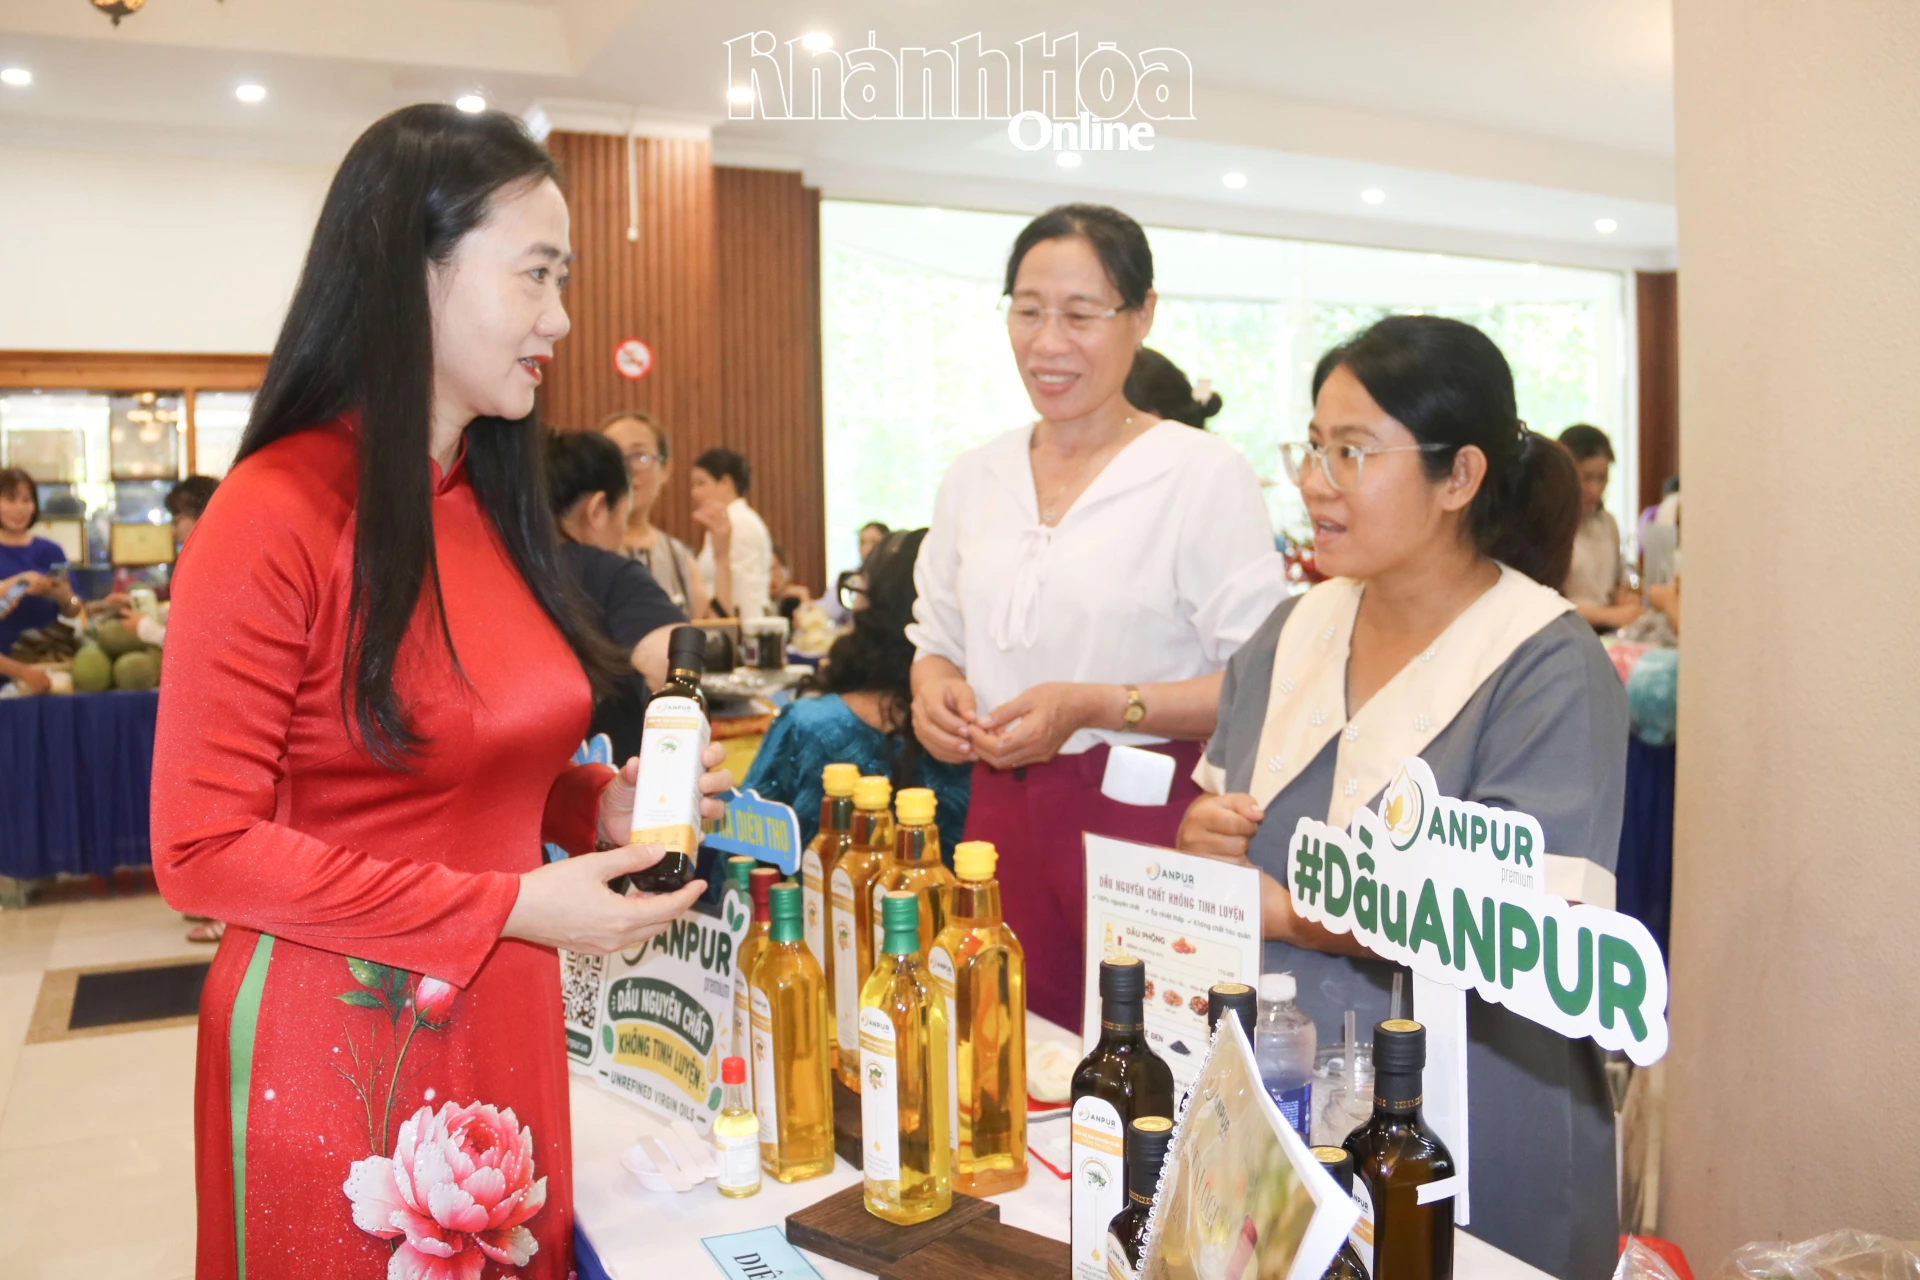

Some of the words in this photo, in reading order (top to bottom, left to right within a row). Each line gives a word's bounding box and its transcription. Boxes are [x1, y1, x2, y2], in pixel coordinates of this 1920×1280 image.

[1427, 806, 1533, 868] ANPUR
[1116, 880, 1144, 898] NGUYÊN
[1147, 886, 1166, 902] CHẤT
[1168, 892, 1195, 910] KHÔNG
[1199, 899, 1216, 915] TINH
[1219, 904, 1245, 924] LUYỆN
[1161, 870, 1195, 885] ANPUR
[1501, 867, 1534, 889] premium
[653, 919, 733, 978] ANPUR
[1294, 824, 1648, 1042] #DầuANPUR
[617, 979, 640, 1013] DẦU
[640, 988, 682, 1026] NGUYÊN
[682, 1005, 710, 1047] CHẤT
[869, 1019, 890, 1031] ANPUR
[618, 1027, 651, 1058] KHÔNG
[653, 1038, 673, 1068] TINH
[673, 1050, 702, 1091] LUYỆN
[610, 1071, 653, 1101] UNREFINED
[654, 1090, 678, 1113] VIRGIN
[679, 1103, 696, 1122] OILS
[1090, 1114, 1116, 1127] ANPUR
